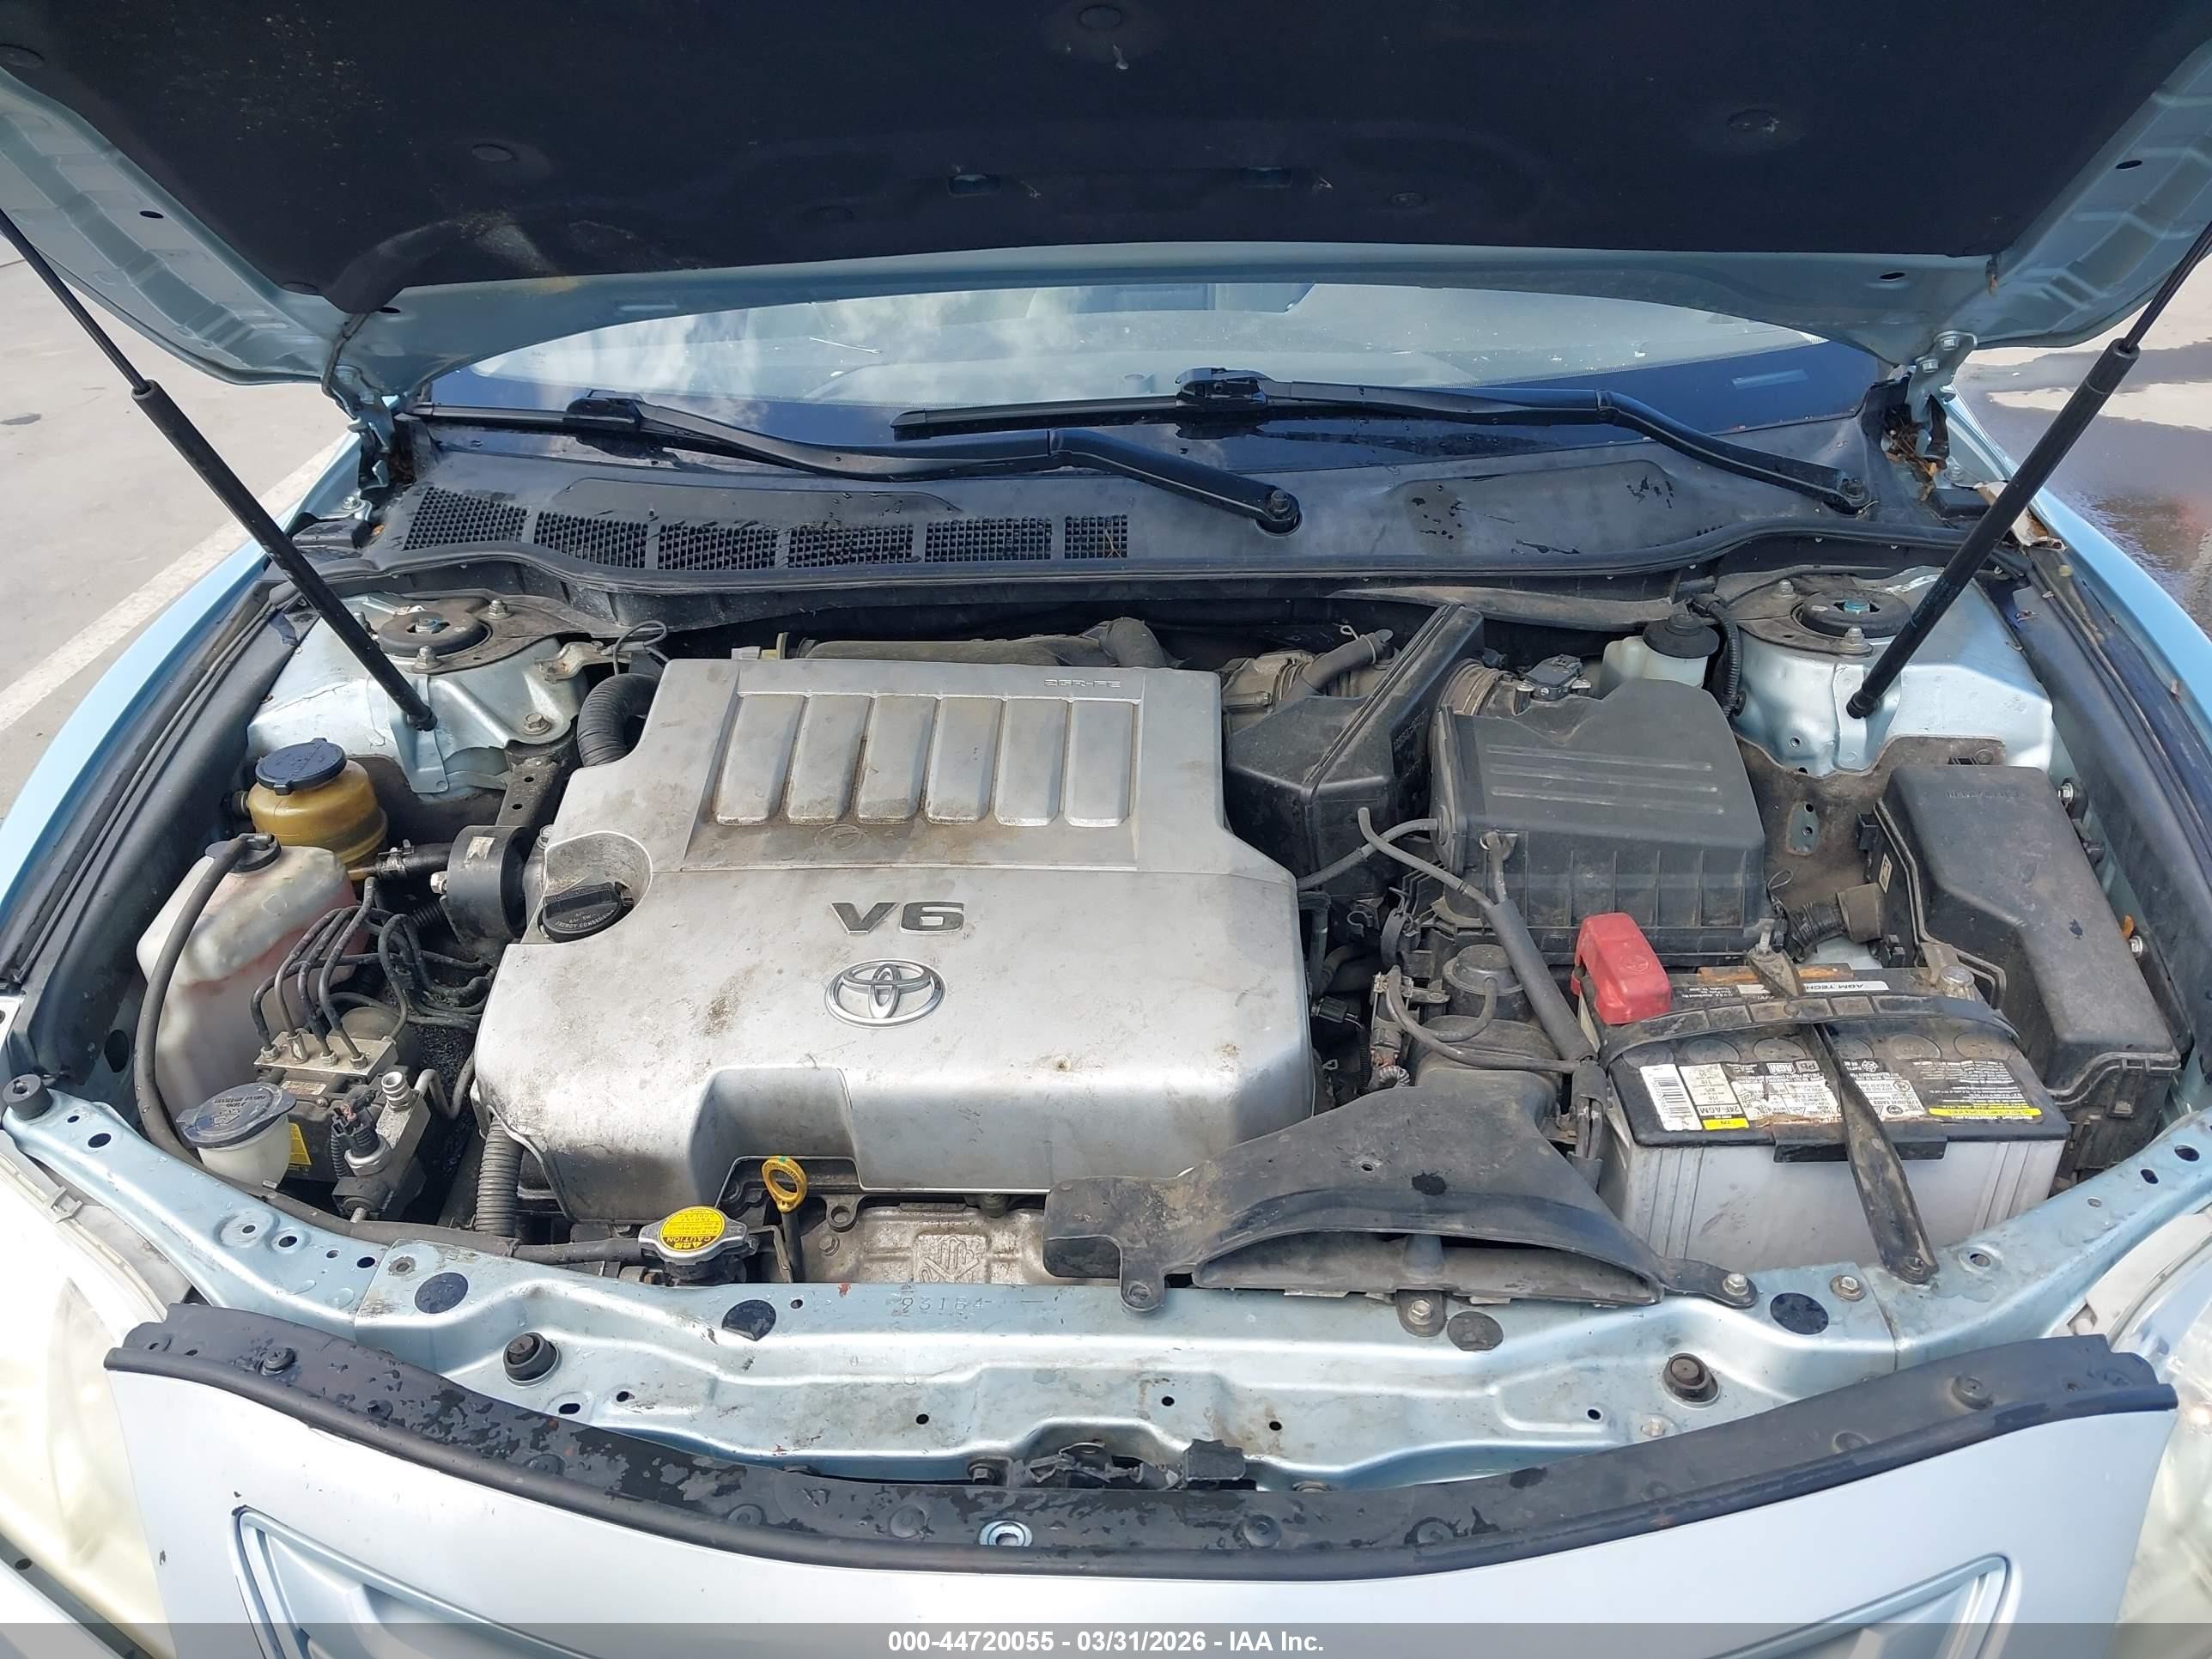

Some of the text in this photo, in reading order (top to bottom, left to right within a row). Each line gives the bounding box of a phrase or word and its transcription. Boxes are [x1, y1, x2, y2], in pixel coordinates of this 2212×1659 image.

[830, 902, 964, 935] V6
[1770, 1062, 1816, 1073] Pb AGM
[1699, 1105, 1740, 1114] 24F-AGM
